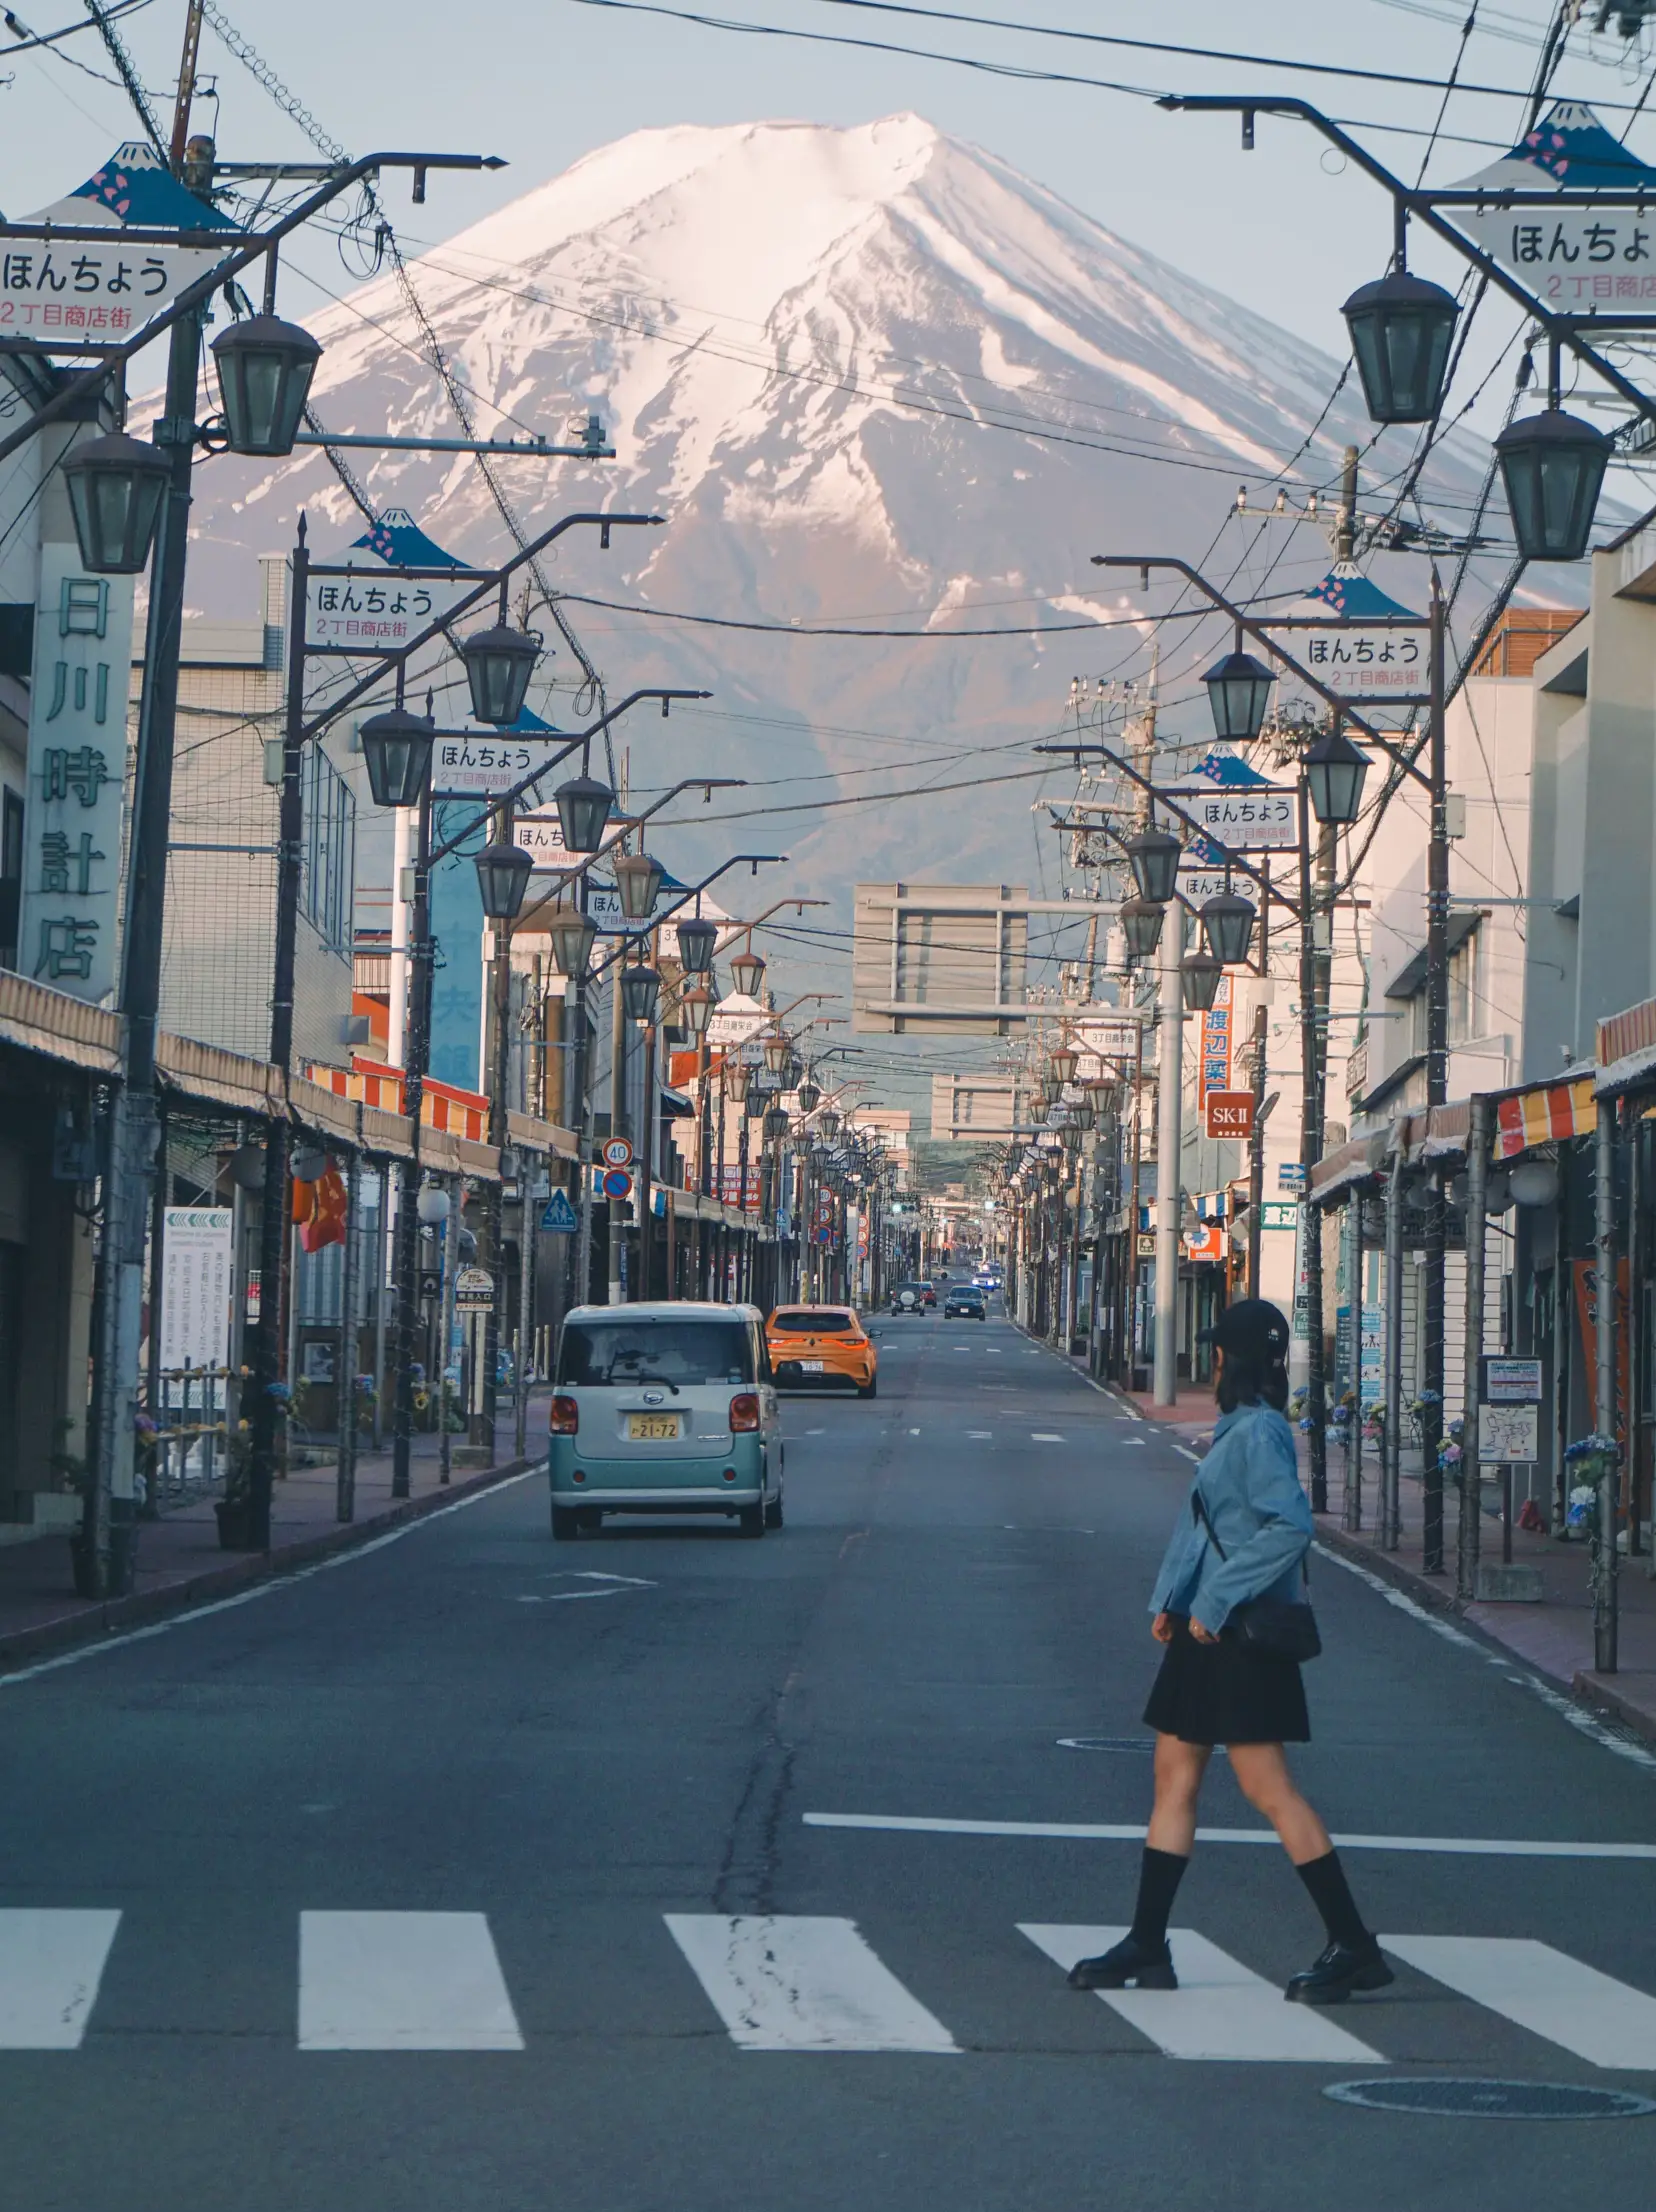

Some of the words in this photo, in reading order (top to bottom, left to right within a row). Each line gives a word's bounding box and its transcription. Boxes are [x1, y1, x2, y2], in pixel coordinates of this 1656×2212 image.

[3, 253, 168, 296] ほんちょう
[0, 302, 132, 330] 2丁目商店街
[318, 585, 432, 616] ほんちょう
[316, 619, 408, 638] 2丁目商店街
[1308, 637, 1419, 664] ほんちょう
[1331, 669, 1420, 686] 2丁目商店街
[441, 745, 531, 769] ほんちょう
[33, 576, 111, 982] 日川時計店
[440, 771, 512, 787] 2丁目商店街
[1205, 801, 1290, 823] ほんちょう
[519, 828, 564, 847] ほんち
[1223, 828, 1290, 840] 2丁目商店街
[1185, 878, 1255, 896] ほんちょう
[1212, 1107, 1248, 1124] SK-II
[609, 1146, 626, 1159] 40
